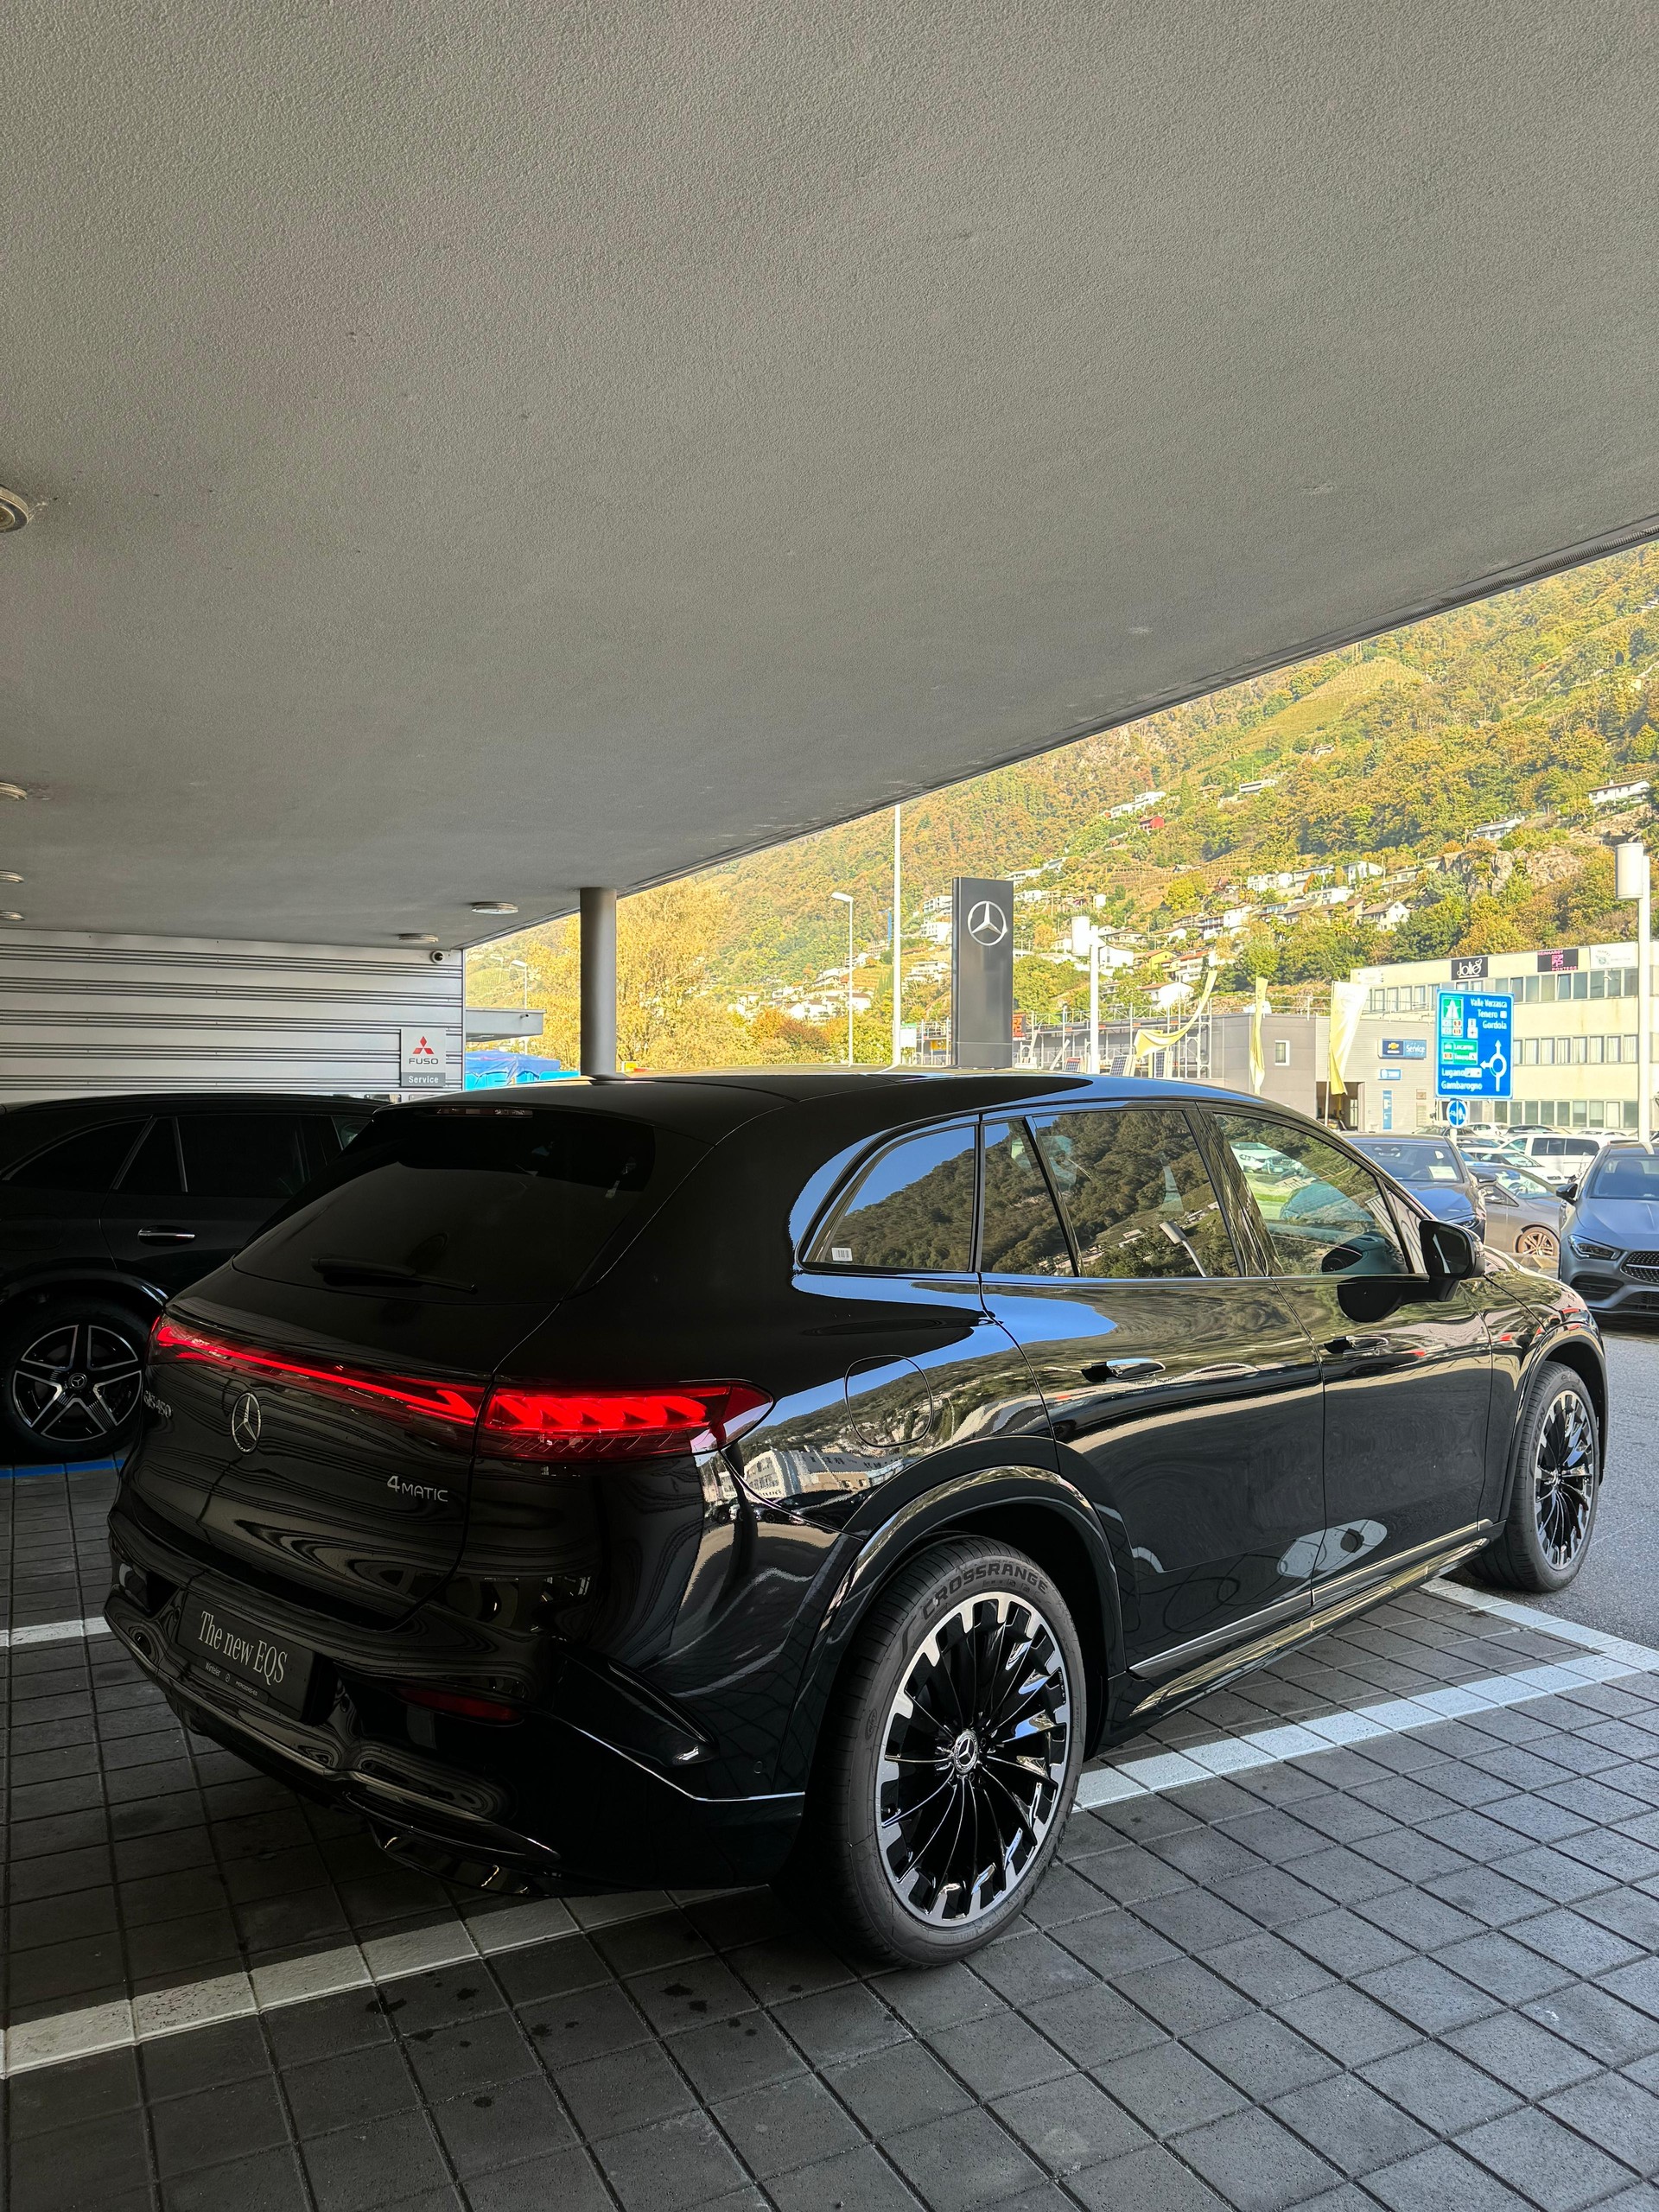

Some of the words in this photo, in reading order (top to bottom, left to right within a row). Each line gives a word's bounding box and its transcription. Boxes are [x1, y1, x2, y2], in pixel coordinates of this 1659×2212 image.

[1470, 997, 1484, 1007] Valle
[1484, 999, 1507, 1008] Verzasca
[1478, 1008, 1498, 1018] Tenero
[1483, 1020, 1507, 1029] Gordola
[1441, 1067, 1465, 1078] Lugano
[408, 1075, 439, 1084] Service
[1441, 1080, 1483, 1092] Gambarogno
[386, 1475, 448, 1503] 4MATIC
[921, 1563, 1048, 1620] CROSSRANGE
[198, 1611, 223, 1649] The
[223, 1632, 254, 1666] new
[252, 1639, 288, 1686] EQS
